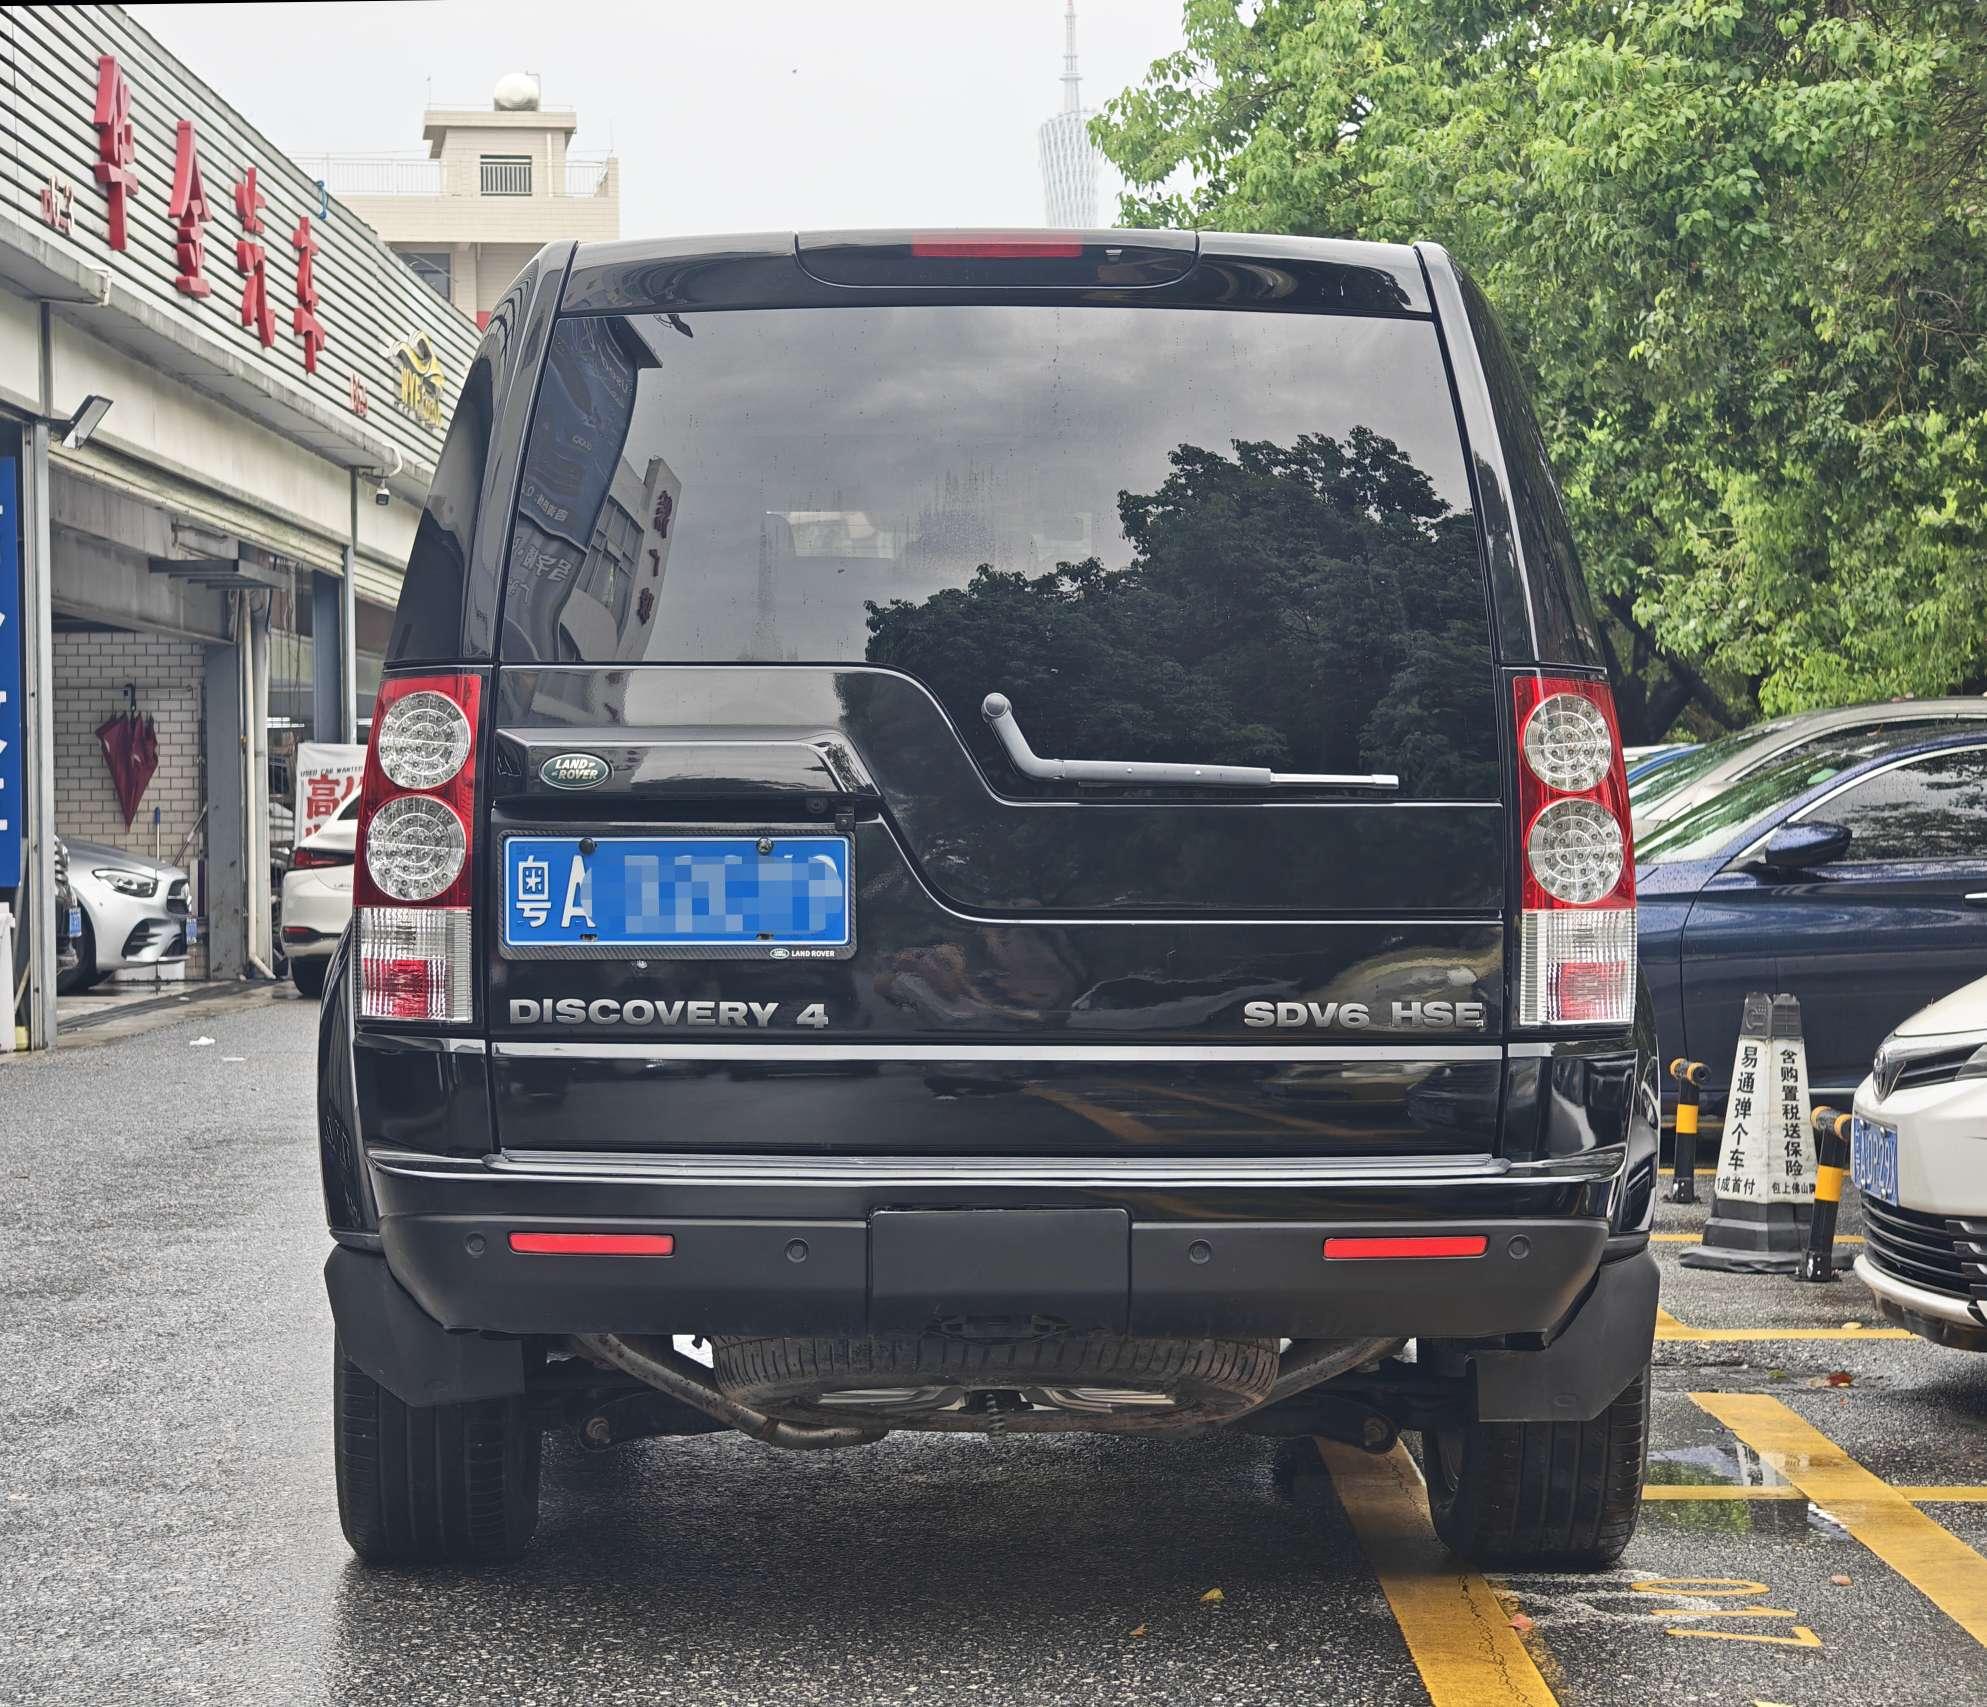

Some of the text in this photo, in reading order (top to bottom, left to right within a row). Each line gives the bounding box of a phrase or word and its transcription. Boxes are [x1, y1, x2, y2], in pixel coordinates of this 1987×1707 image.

[300, 768, 318, 777] USED
[321, 767, 334, 775] CAR
[555, 759, 588, 769] LAND
[558, 769, 598, 779] ROVER
[509, 998, 829, 1029] DISCOVERY 4
[1244, 1001, 1484, 1029] SDV6 HSE
[1728, 1046, 1758, 1171] 易通弹个车
[1780, 1049, 1803, 1177] 含购置税送保险
